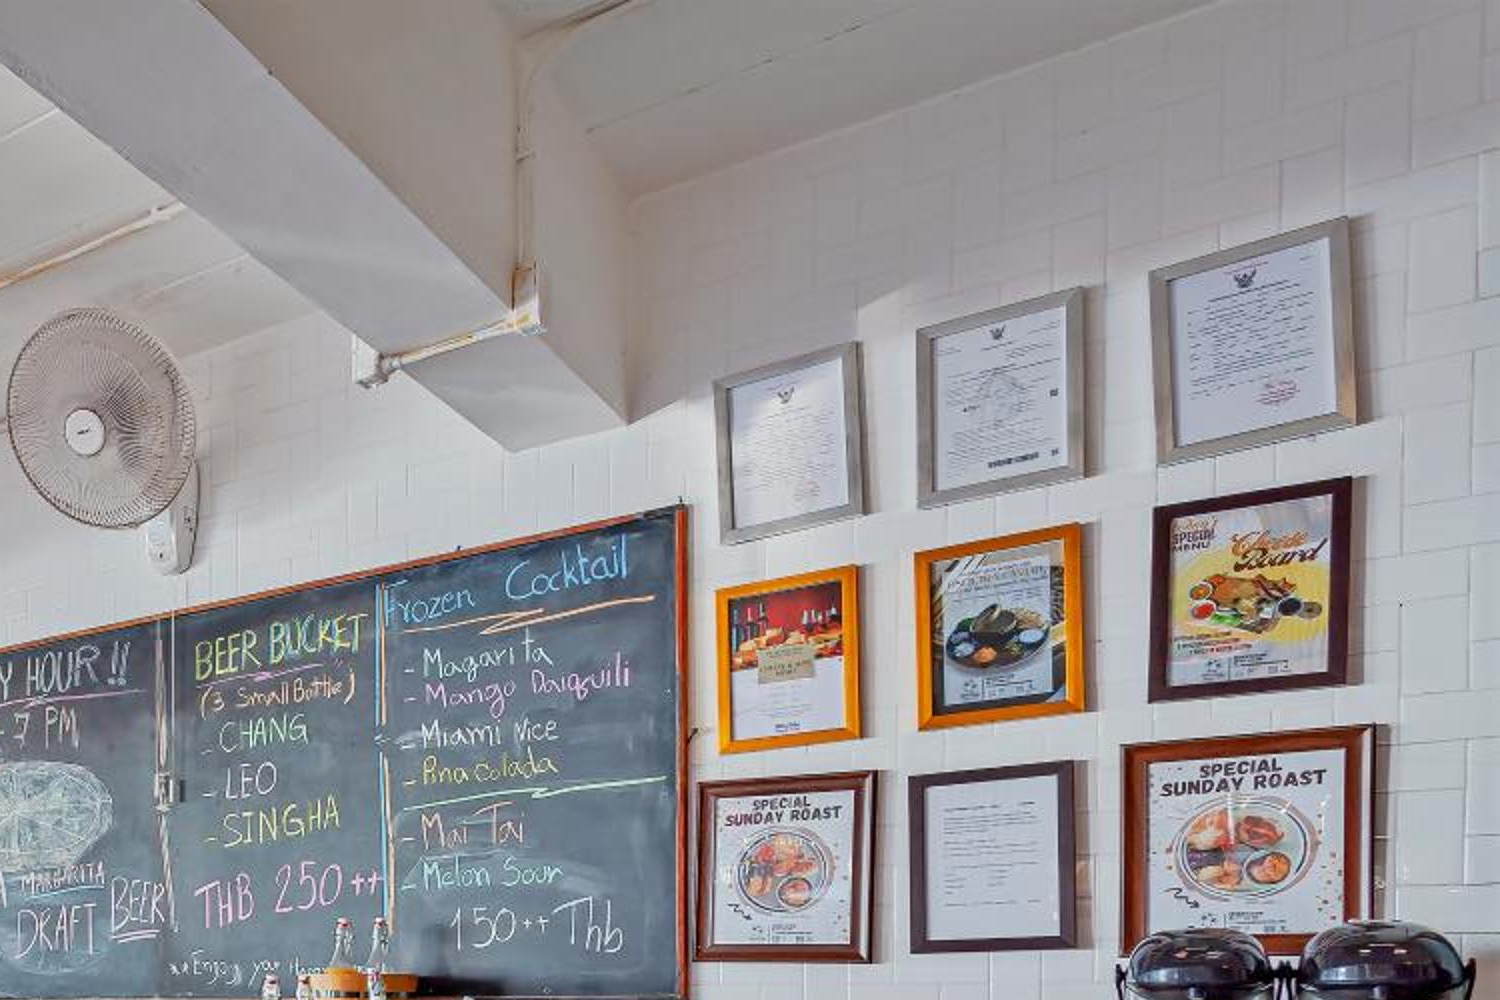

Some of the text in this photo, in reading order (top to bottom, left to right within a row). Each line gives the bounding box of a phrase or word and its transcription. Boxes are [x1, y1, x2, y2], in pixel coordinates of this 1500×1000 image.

[386, 533, 627, 627] Frozen Cocktail
[195, 612, 368, 682] BEER BUCKET
[27, 644, 100, 697] HOUR
[45, 705, 80, 749] PM
[219, 713, 309, 754] CHANG
[421, 720, 502, 749] Miami
[224, 761, 277, 800] LEO
[1160, 769, 1327, 797] SUNDAY ROAST
[1200, 758, 1283, 779] SPECIAL
[223, 796, 341, 848] SINGHA
[725, 806, 842, 827] SUNDAY ROAST
[752, 796, 811, 811] SPECIAL
[421, 801, 523, 850] Mai Tai
[422, 856, 491, 890] Melon
[14, 902, 97, 959] DRAFT
[111, 877, 165, 931] BEER
[195, 872, 255, 929] THB
